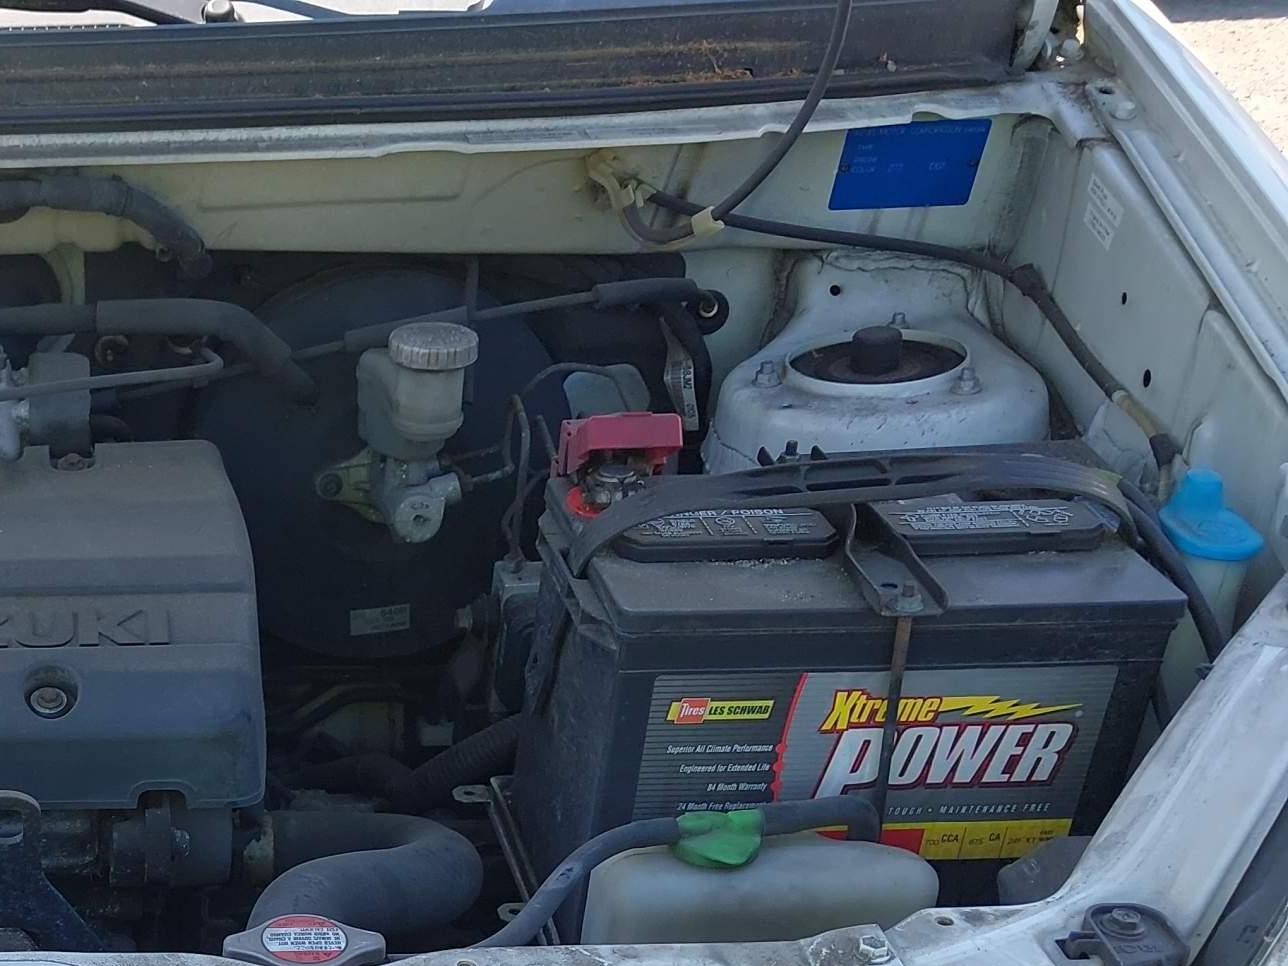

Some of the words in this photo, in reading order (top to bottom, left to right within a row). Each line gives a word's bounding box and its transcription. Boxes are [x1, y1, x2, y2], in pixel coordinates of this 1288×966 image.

[680, 703, 706, 718] Tires
[708, 706, 726, 715] LES
[726, 705, 770, 715] SCHWAB
[821, 691, 943, 731] Xtreme
[666, 745, 695, 755] Superior
[695, 744, 706, 753] All
[706, 744, 731, 753] Climate
[732, 744, 773, 753] Performance
[814, 722, 1074, 800] POWER
[679, 764, 716, 774] Engineered
[716, 763, 727, 772] for
[727, 763, 756, 772] Extended
[757, 763, 770, 771] Life
[706, 783, 716, 792] 84
[716, 783, 737, 791] Month
[738, 782, 768, 792] Warranty
[687, 802, 708, 811] Month
[708, 802, 723, 810] Free
[888, 806, 923, 816] TOUGH
[939, 803, 1017, 815] MAINTENANCE
[1022, 802, 1051, 812] FREE
[941, 833, 959, 843] CCA
[988, 832, 1001, 842] CA
